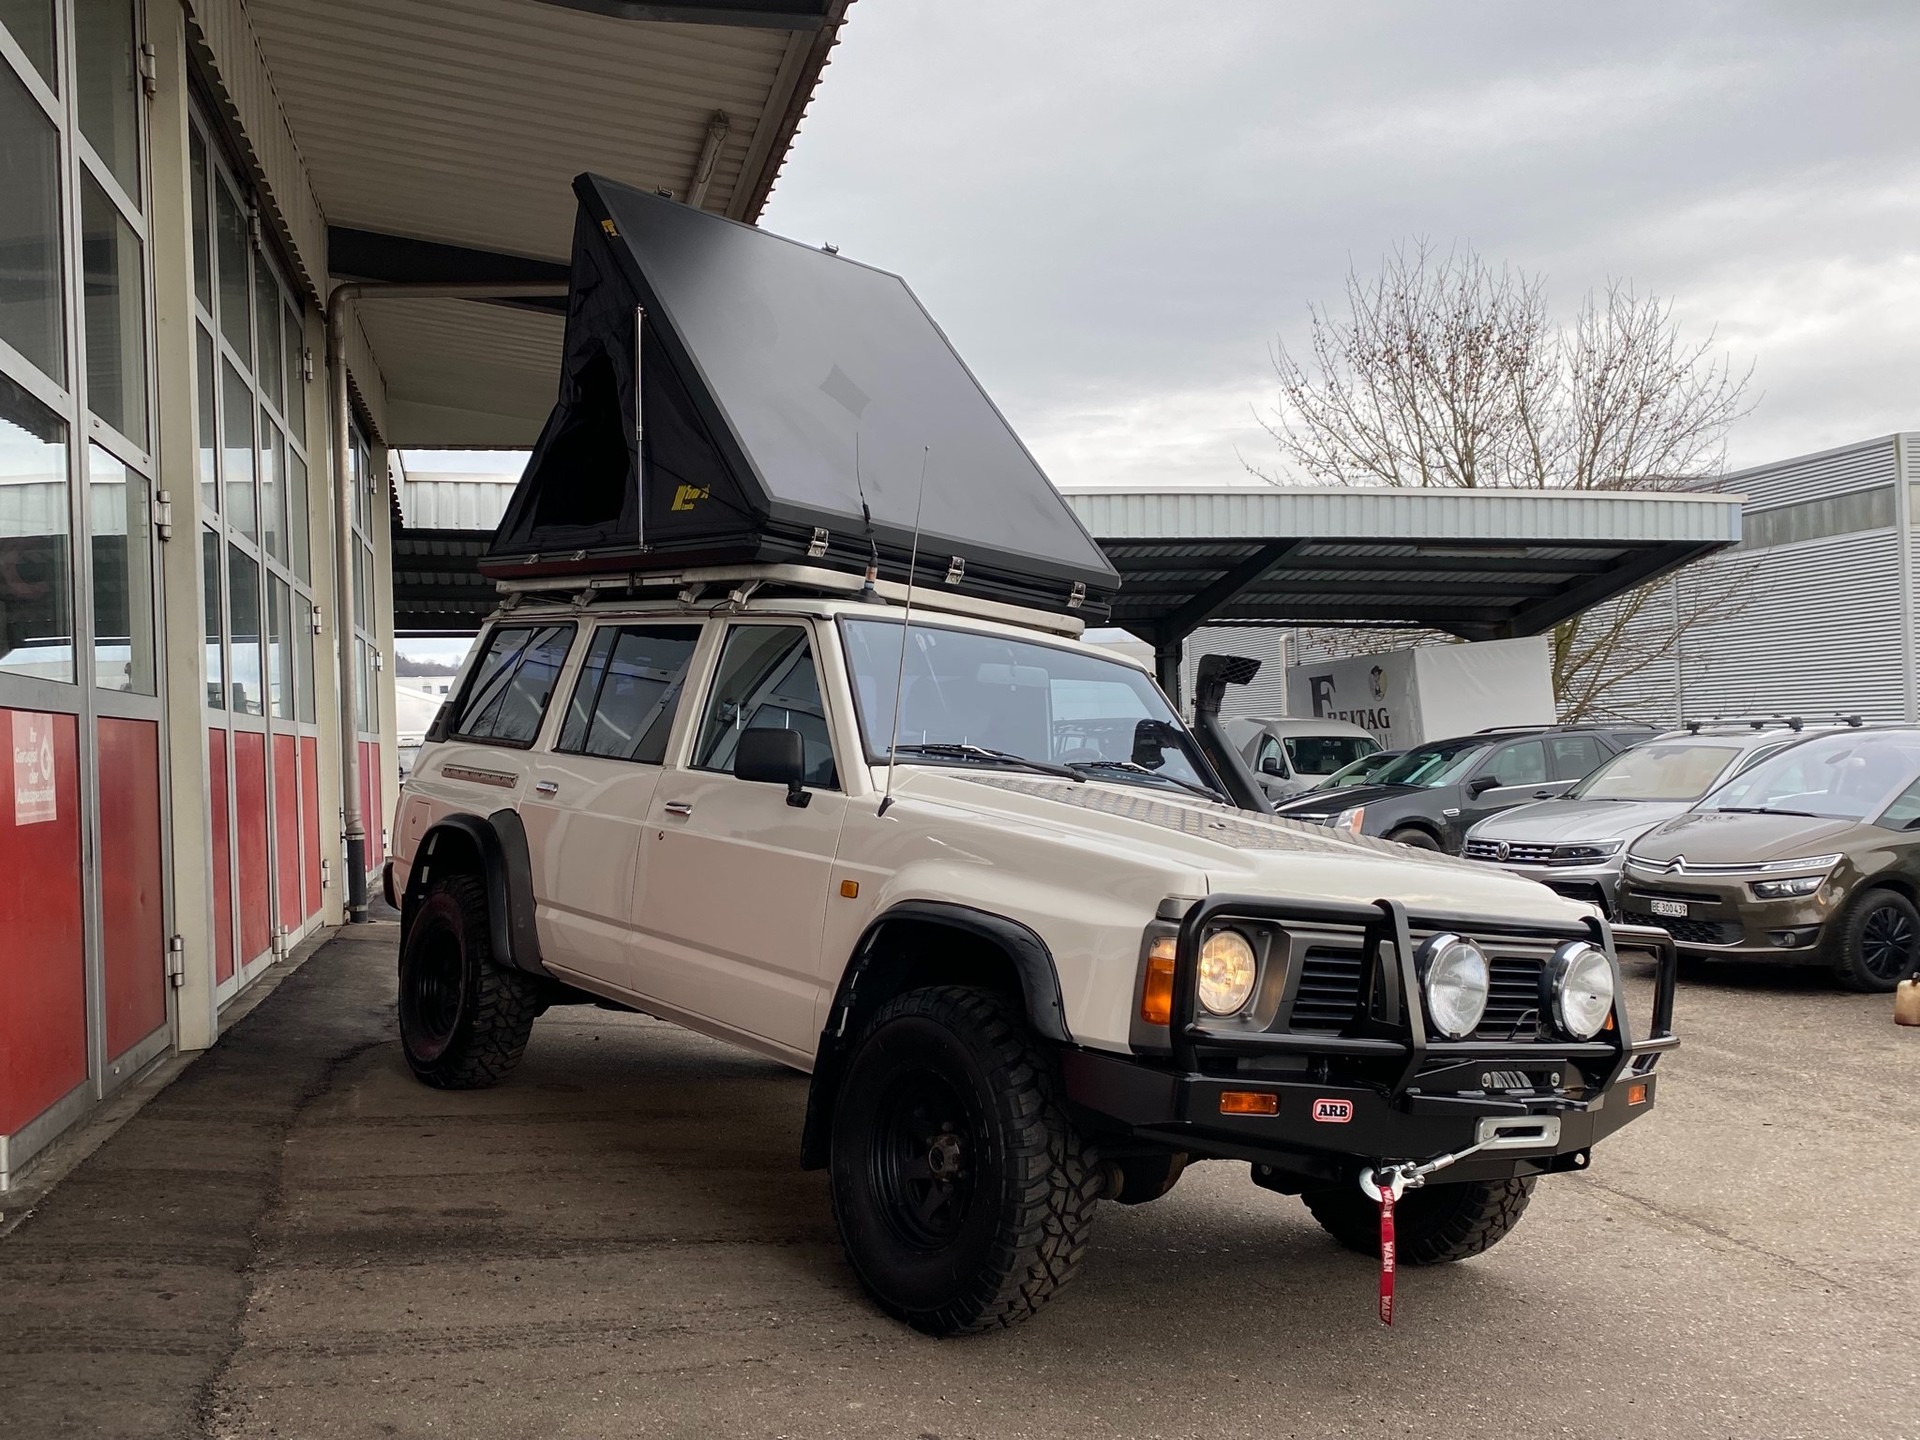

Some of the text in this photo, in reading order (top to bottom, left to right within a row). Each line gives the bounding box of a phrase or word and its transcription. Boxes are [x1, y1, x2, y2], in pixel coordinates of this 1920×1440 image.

[1318, 1104, 1348, 1117] ARB
[1383, 1189, 1394, 1218] WARN
[1383, 1241, 1394, 1273] WARN
